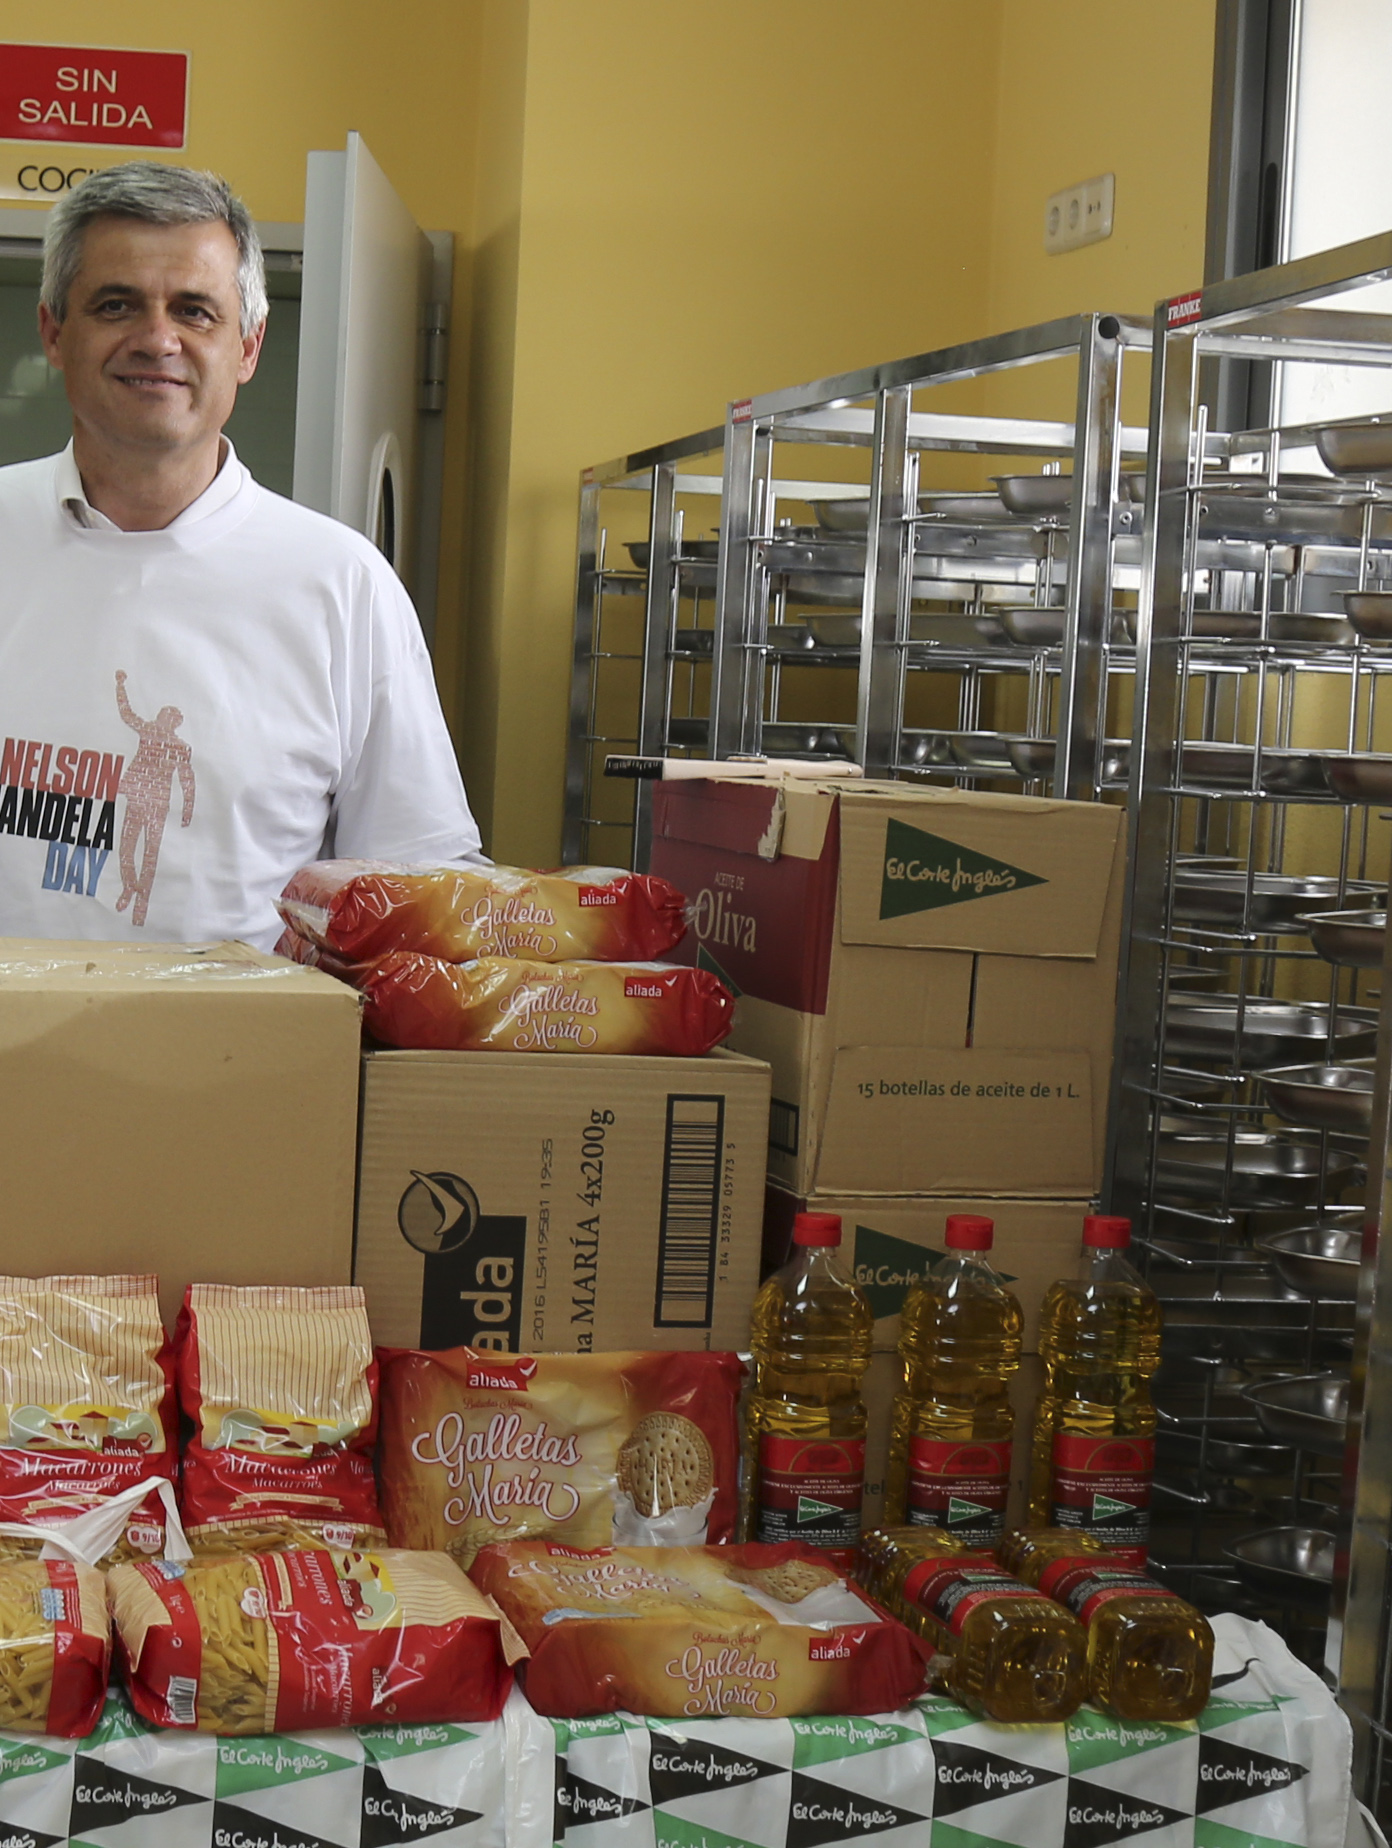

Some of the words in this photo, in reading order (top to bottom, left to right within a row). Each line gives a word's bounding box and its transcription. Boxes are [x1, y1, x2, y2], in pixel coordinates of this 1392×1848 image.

[56, 66, 117, 93] SIN
[18, 98, 153, 129] SALIDA
[17, 165, 99, 192] COC
[1168, 298, 1201, 322] FRANKE
[0, 737, 124, 802] NELSON
[42, 840, 109, 897] DAY
[714, 872, 735, 889] ACEITE
[736, 876, 744, 891] DE
[580, 890, 617, 906] aliada
[460, 897, 557, 940] Galletas
[694, 888, 756, 953] Oliva
[476, 927, 557, 959] María
[498, 984, 599, 1018] Galletas
[625, 983, 662, 998] aliada
[513, 1016, 597, 1049] María
[858, 1083, 874, 1098] 15
[880, 1080, 945, 1096] botellas
[950, 1081, 970, 1097] de
[976, 1082, 1024, 1097] aceite
[1030, 1083, 1050, 1098] de
[577, 1109, 615, 1208] 4x200g
[725, 1158, 736, 1196] 05773
[721, 1205, 732, 1243] 33329
[570, 1215, 601, 1325] MARÍA
[720, 1250, 729, 1267] 84
[533, 1294, 545, 1341] 2016
[469, 1372, 518, 1390] aliada
[104, 1447, 139, 1457] aliada
[411, 1411, 583, 1488] Galletas
[19, 1457, 142, 1476] Macarrones
[444, 1463, 580, 1525] María
[336, 1529, 353, 1541] 9/10
[336, 1578, 354, 1608] aliada
[810, 1646, 851, 1661] aliada
[665, 1646, 778, 1694] Galletas
[684, 1679, 777, 1716] María
